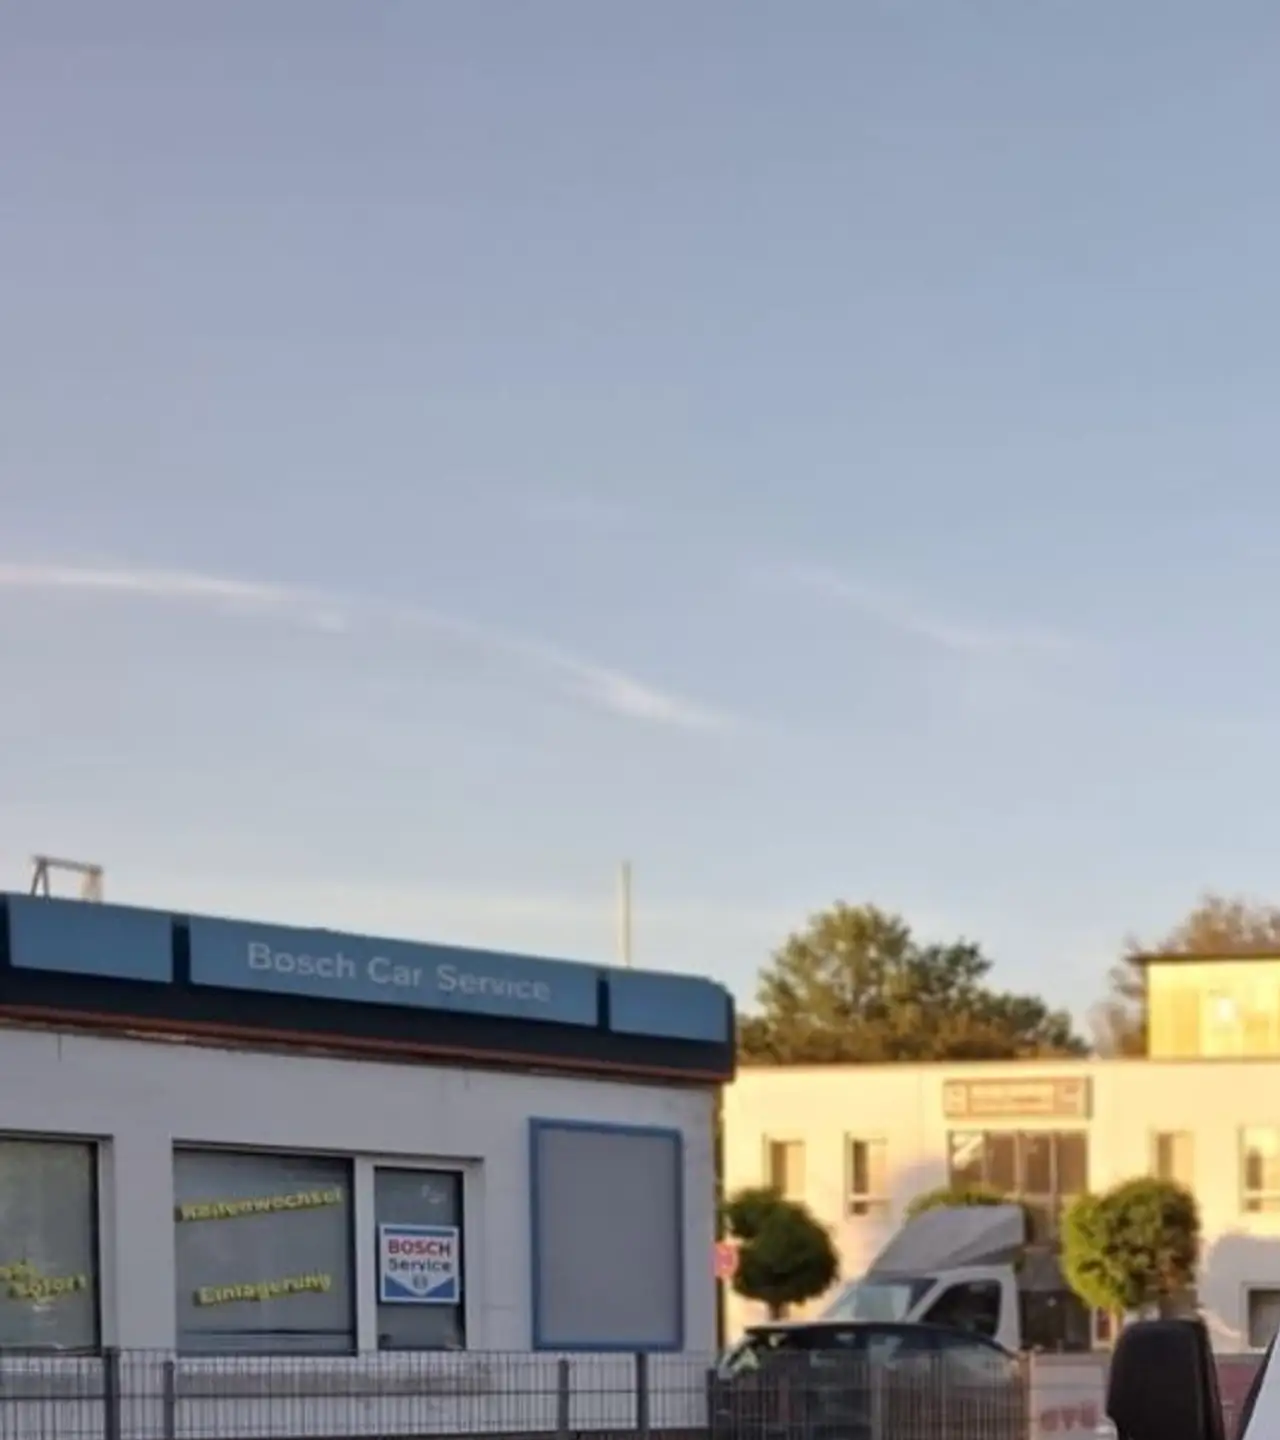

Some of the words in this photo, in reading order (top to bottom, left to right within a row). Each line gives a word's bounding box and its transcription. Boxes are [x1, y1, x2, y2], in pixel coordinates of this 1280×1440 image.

[248, 942, 355, 980] Bosch
[367, 956, 423, 988] Car
[436, 963, 551, 1003] Service
[388, 1238, 452, 1258] BOSCH
[388, 1257, 452, 1273] Service
